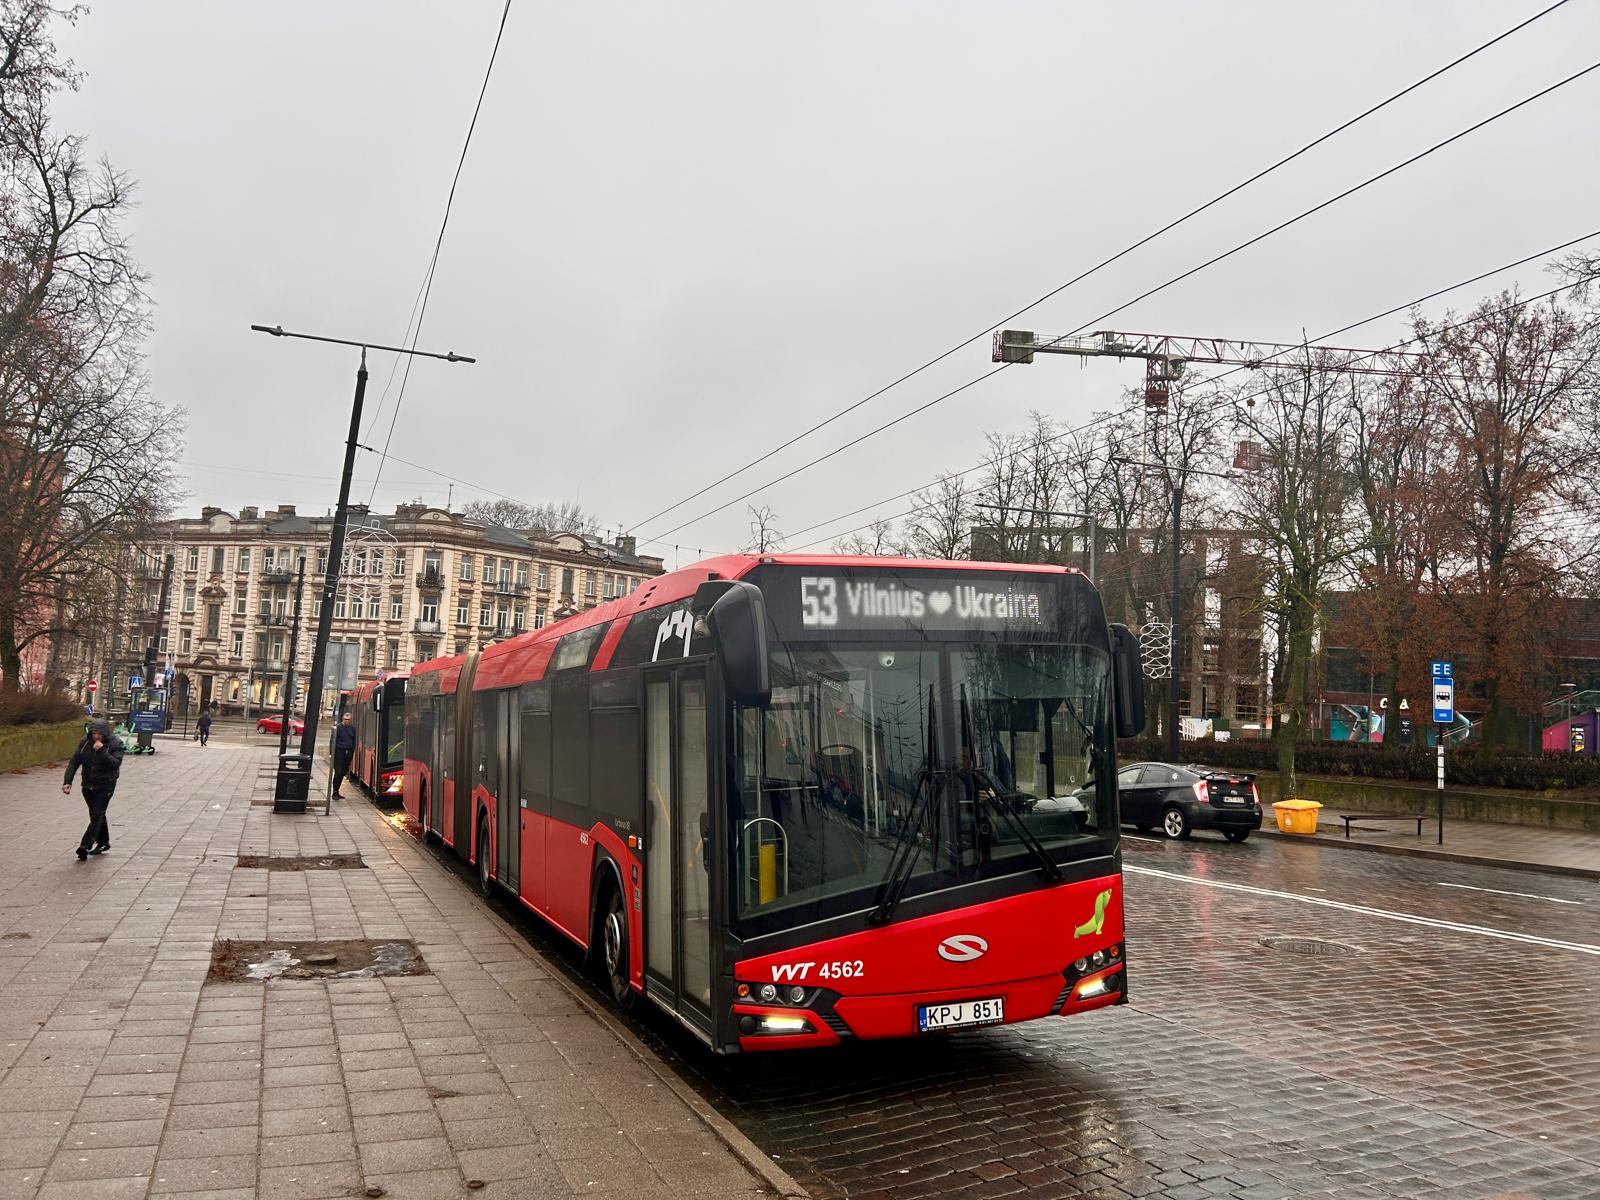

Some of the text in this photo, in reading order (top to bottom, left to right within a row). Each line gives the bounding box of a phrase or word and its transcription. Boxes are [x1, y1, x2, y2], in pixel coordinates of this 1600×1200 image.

[801, 577, 1041, 625] 53 Vilnius Ukrainą
[819, 960, 864, 979] 4562
[928, 1001, 999, 1025] KPJ 851
